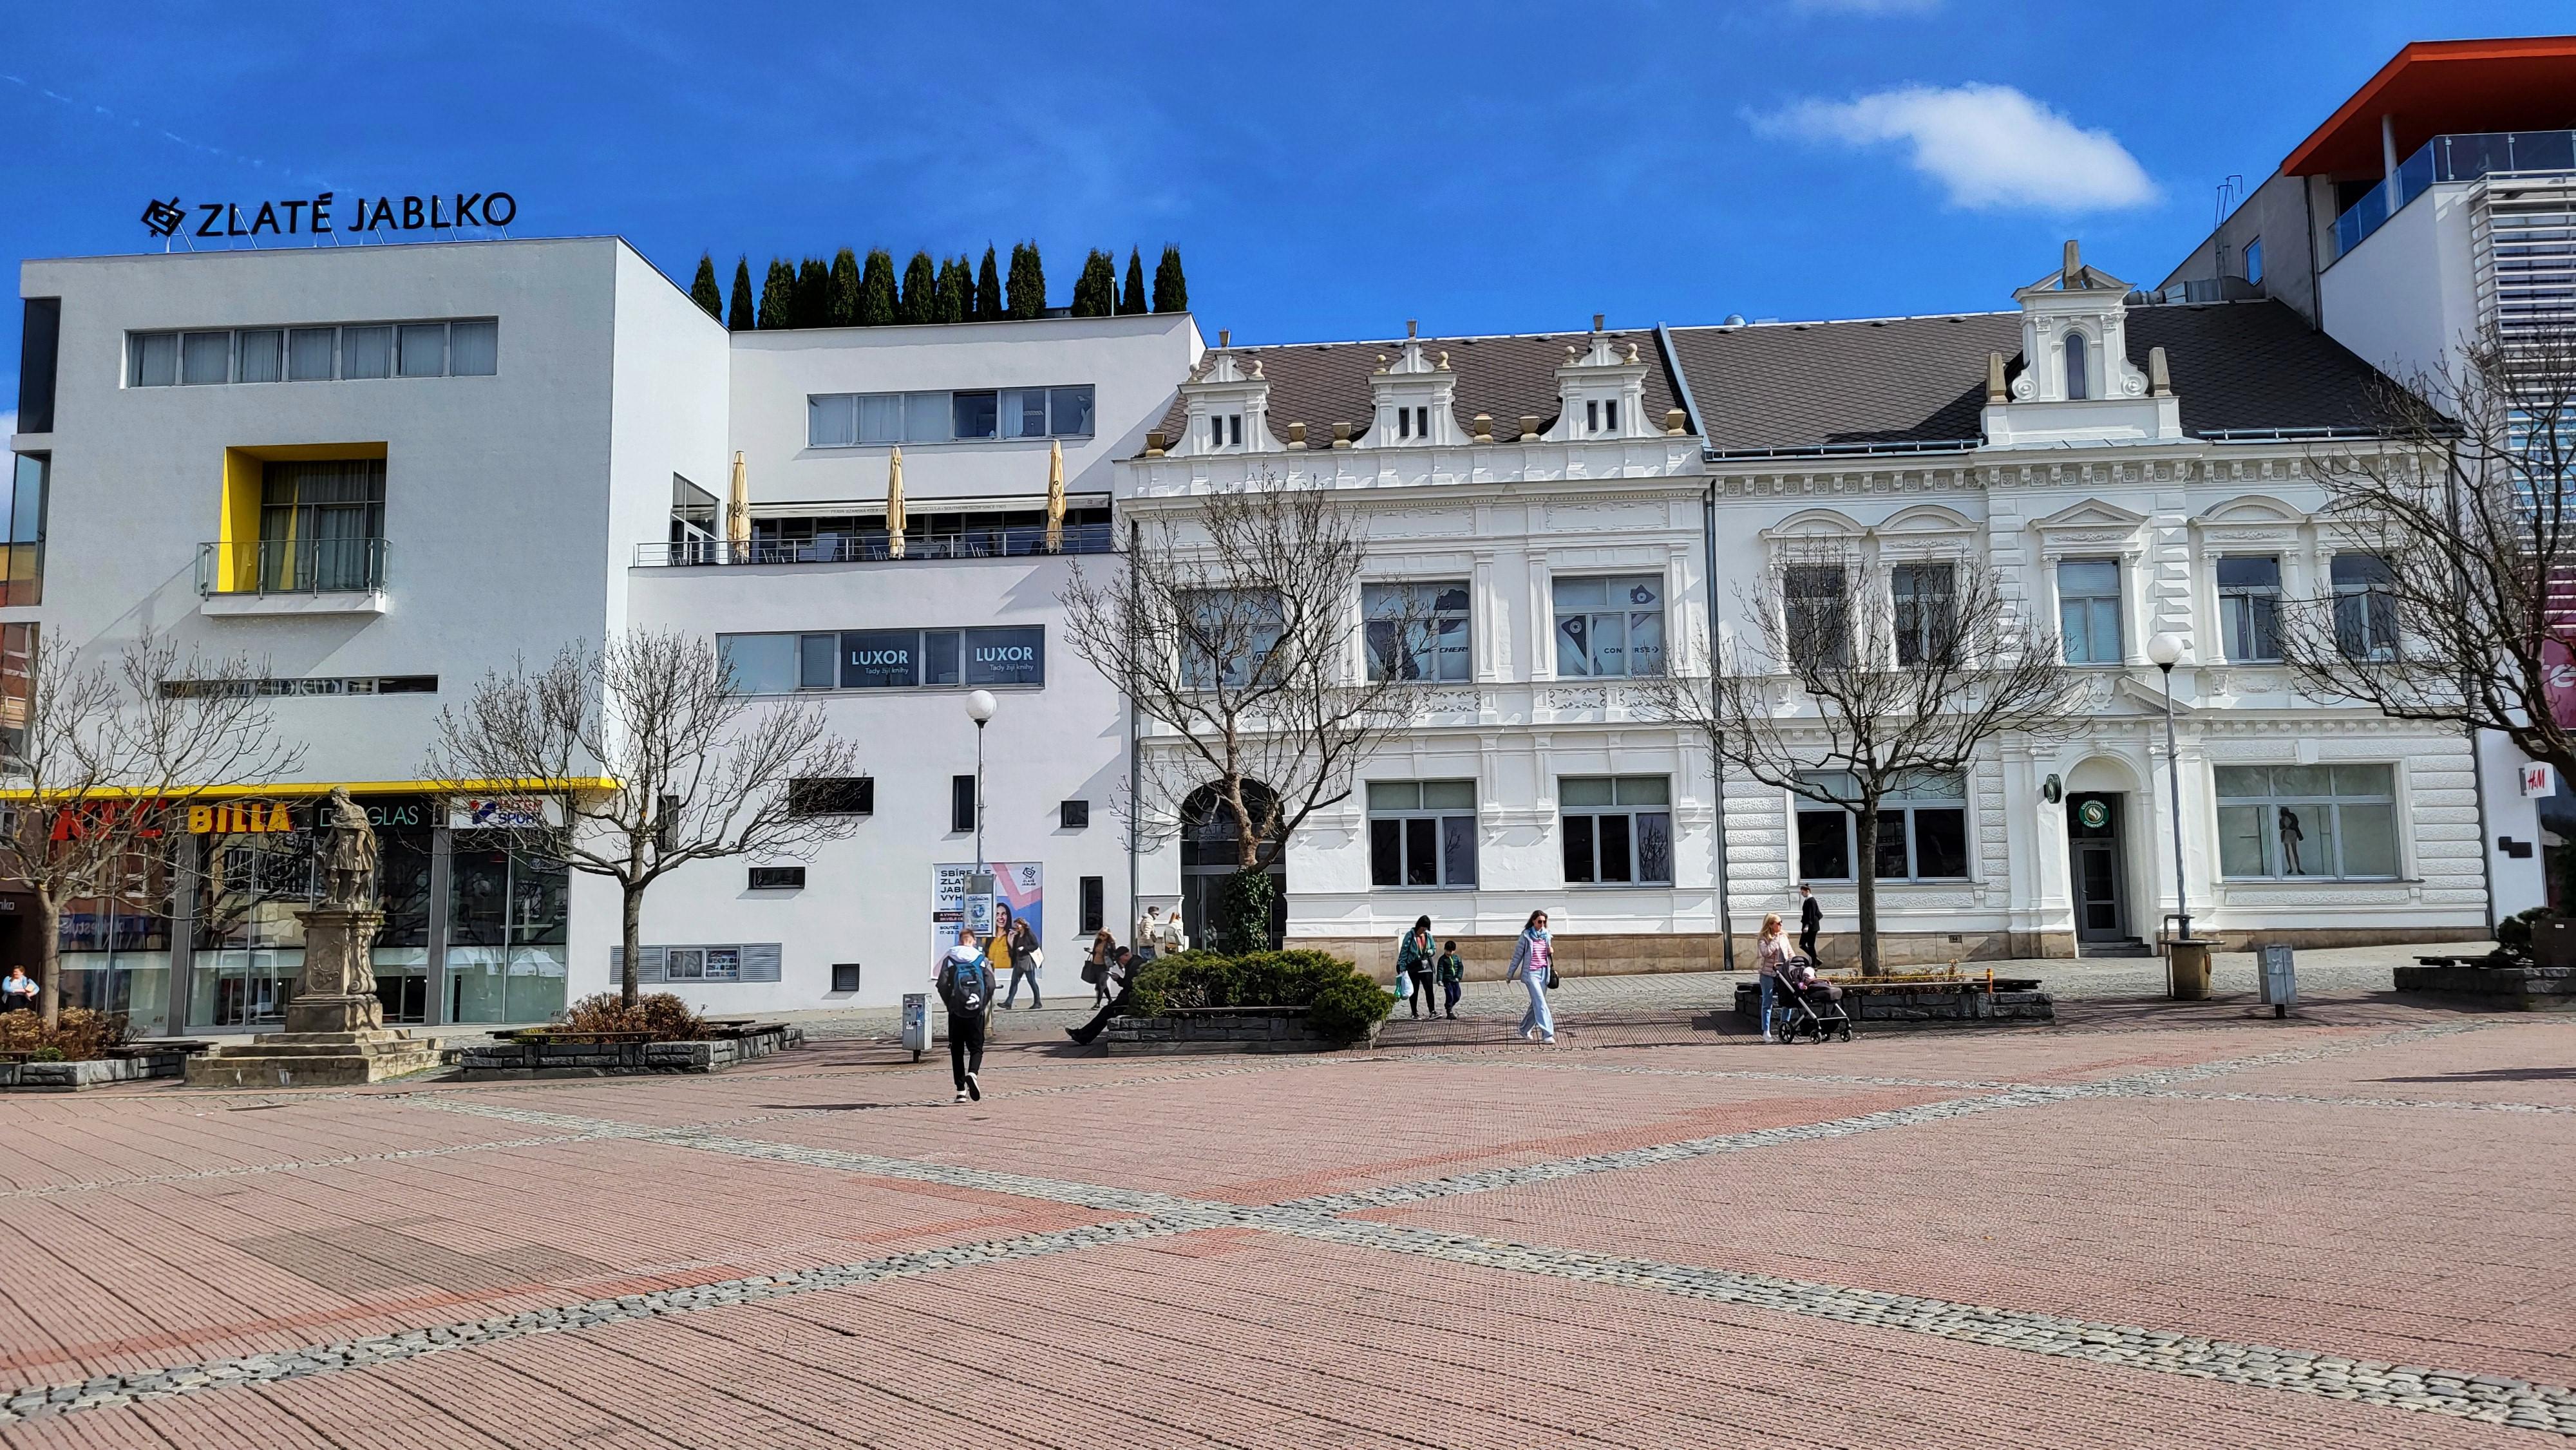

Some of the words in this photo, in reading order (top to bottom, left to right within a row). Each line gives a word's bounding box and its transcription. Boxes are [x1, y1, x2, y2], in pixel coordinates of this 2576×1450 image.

[196, 191, 334, 237] ZLATÉ
[348, 191, 516, 232] JABLKO
[851, 650, 909, 665] LUXOR
[976, 646, 1034, 662] LUXOR
[892, 666, 909, 675] knihy
[1016, 663, 1034, 672] knihy
[2528, 767, 2545, 790] H&M
[51, 798, 168, 840] KFC
[188, 803, 294, 834] BILLA
[319, 805, 419, 827] DGLAS
[941, 868, 992, 876] SBÍREE
